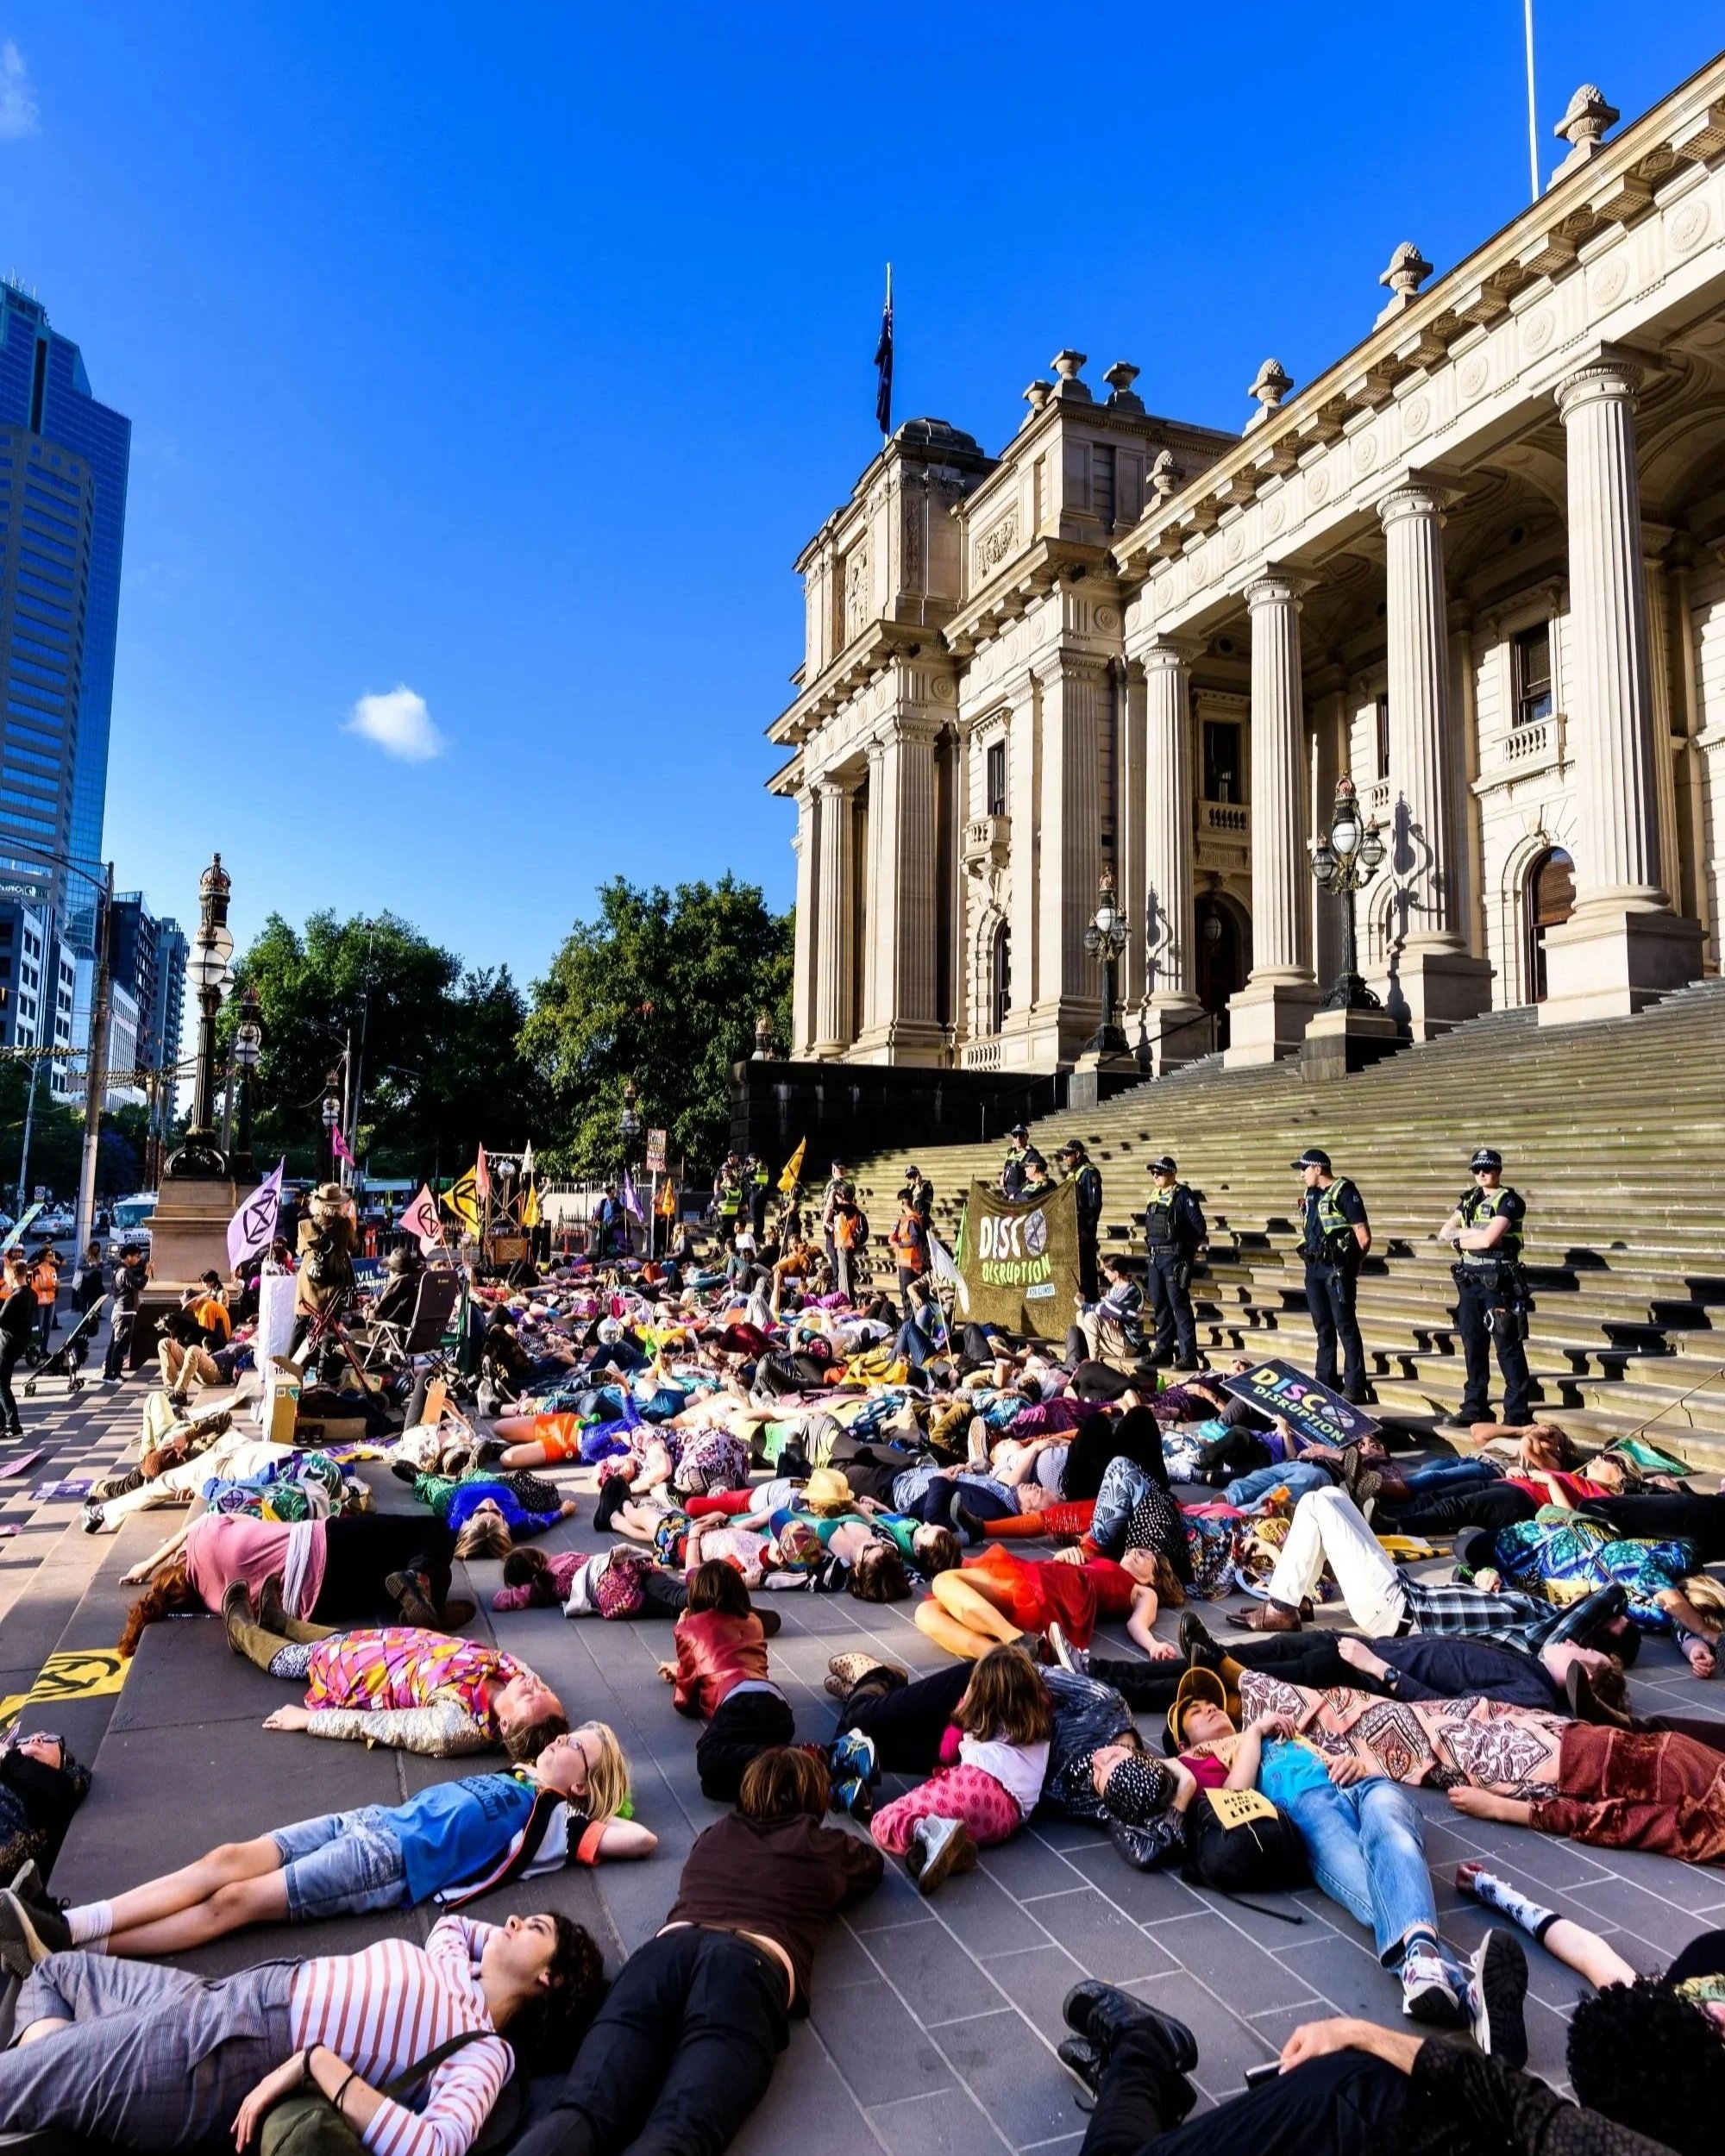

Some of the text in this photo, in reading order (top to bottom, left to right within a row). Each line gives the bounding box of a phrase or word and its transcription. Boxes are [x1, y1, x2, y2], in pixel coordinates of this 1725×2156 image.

[649, 1144, 664, 1153] NEEDS
[982, 1253, 1051, 1285] DISRUPTION
[1252, 1385, 1346, 1442] DISRUPTION
[1231, 1802, 1263, 1818] LIFE
